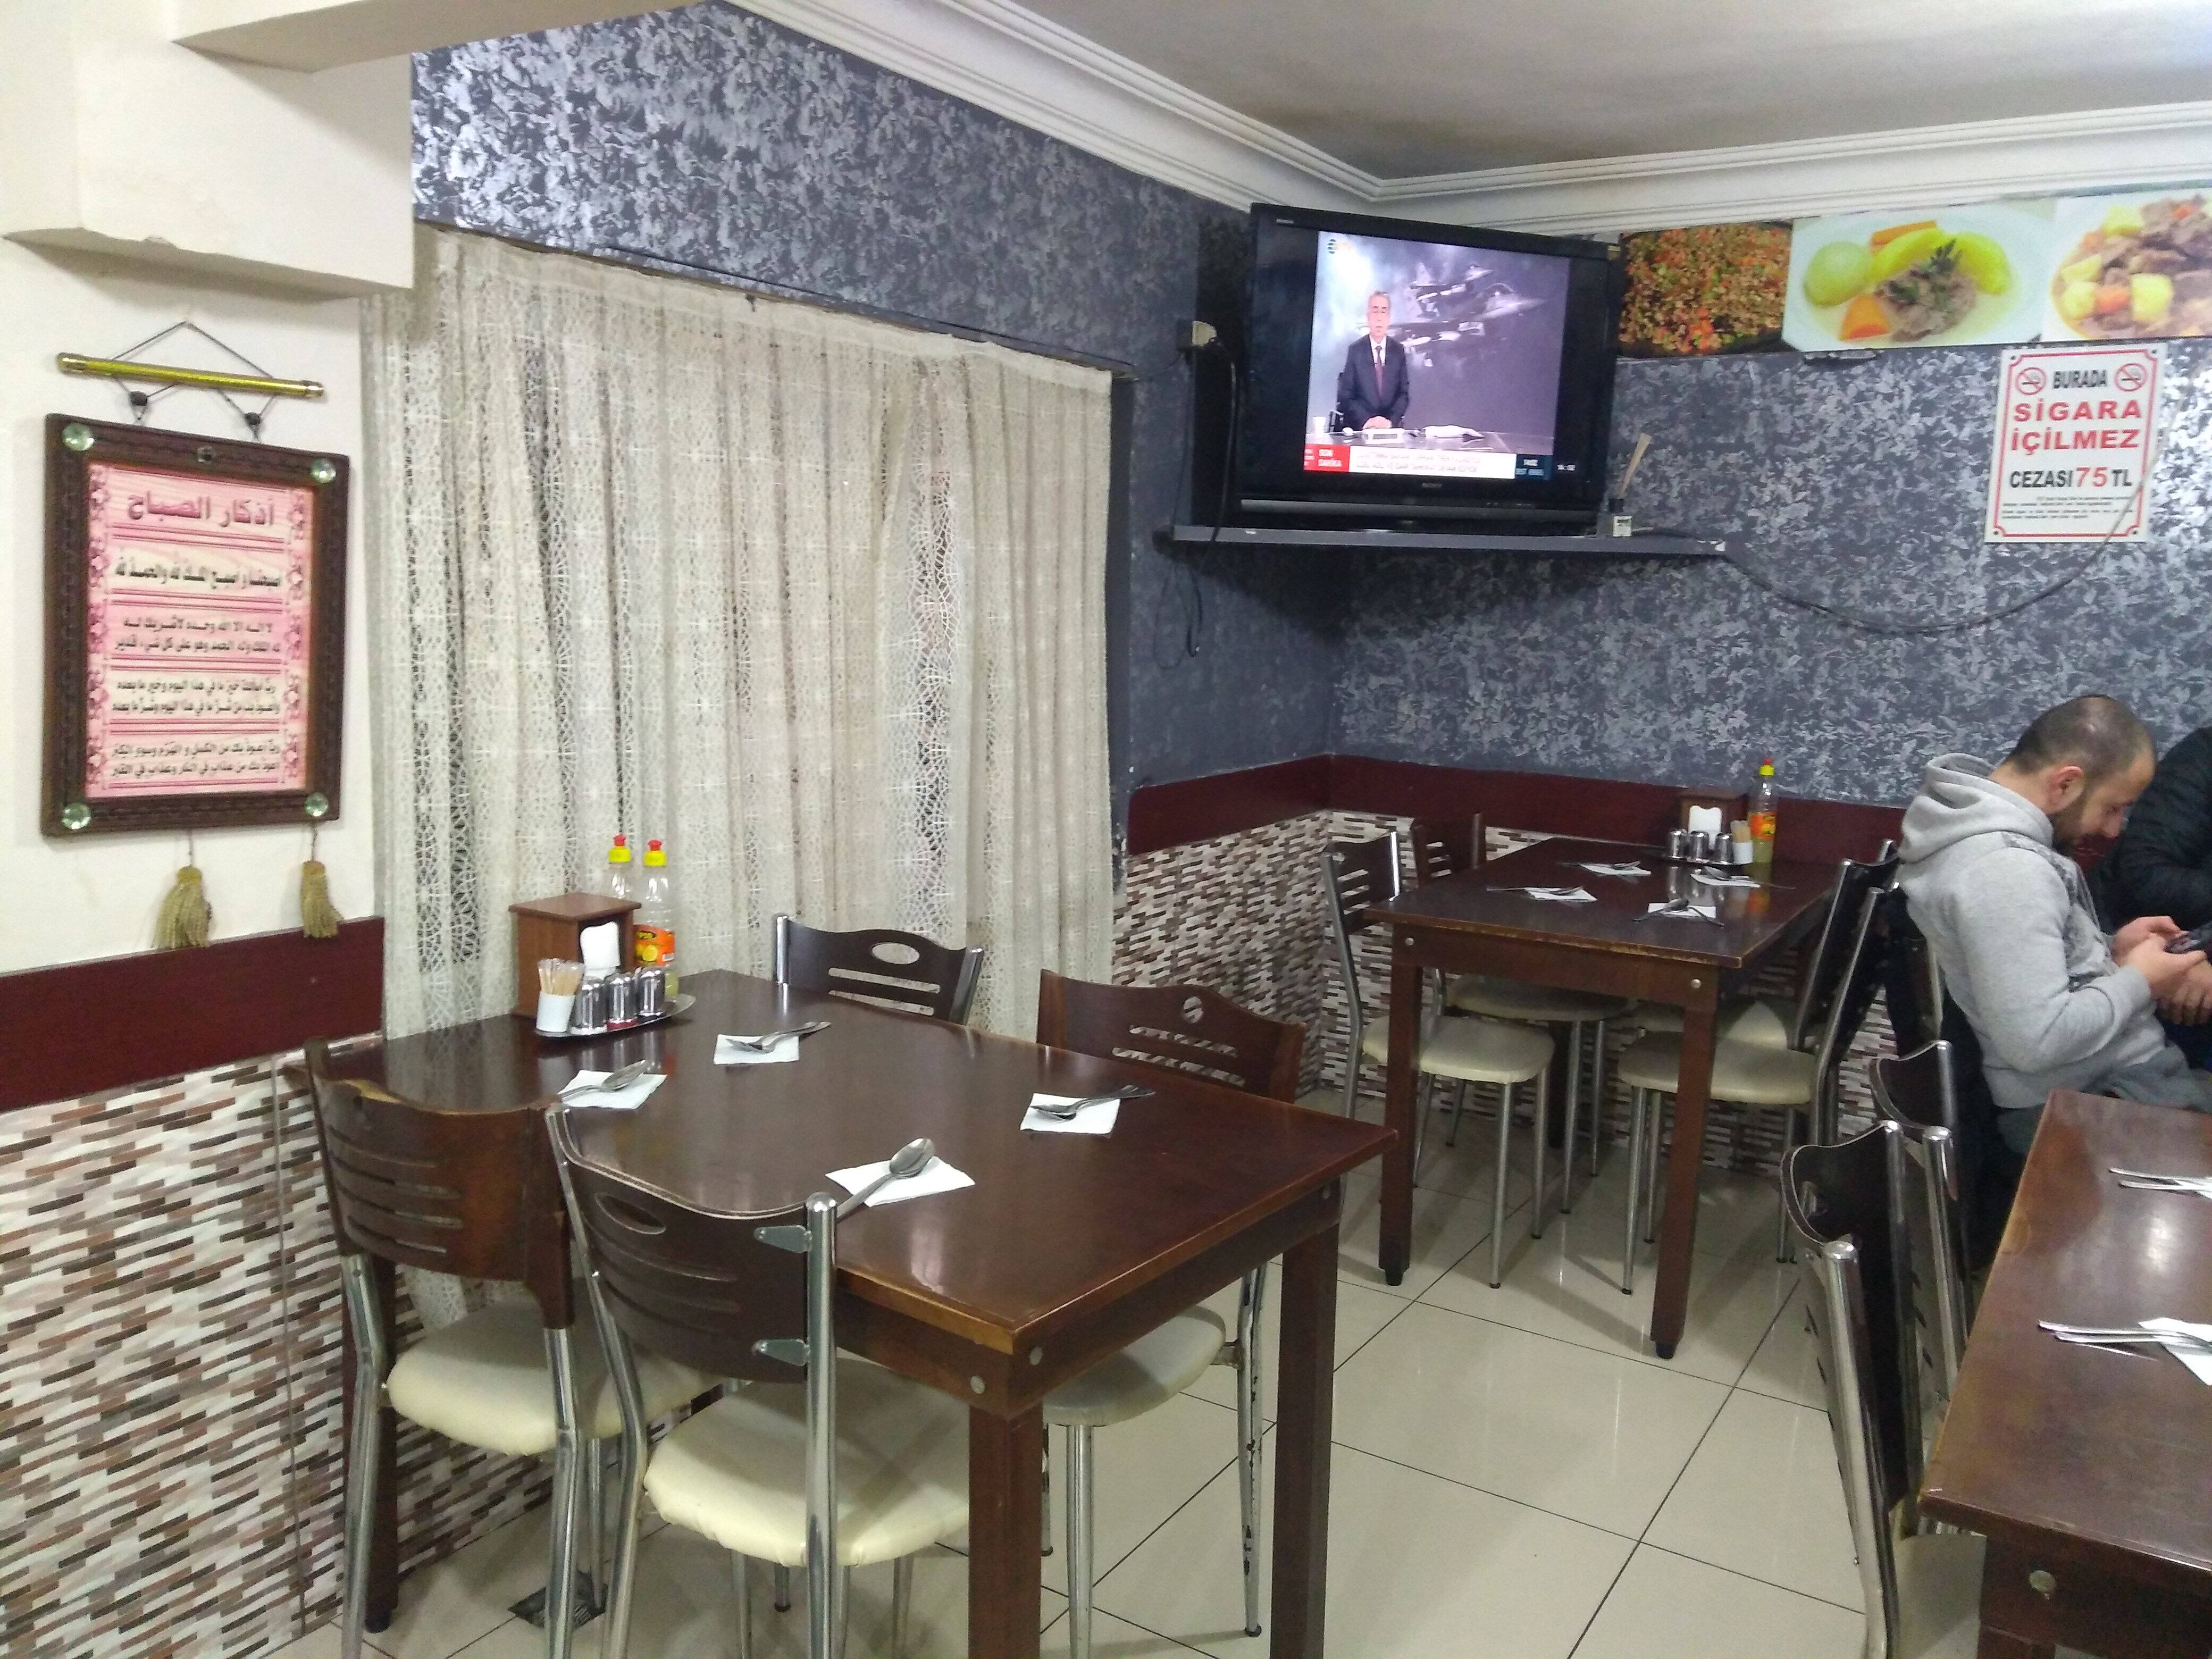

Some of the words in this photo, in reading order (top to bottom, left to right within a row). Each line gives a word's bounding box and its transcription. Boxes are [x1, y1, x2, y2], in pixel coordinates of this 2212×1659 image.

[2052, 370, 2107, 389] BURADA
[2013, 399, 2142, 422] SİGARA
[2011, 427, 2140, 455] İÇİLMEZ
[2010, 469, 2073, 489] CEZASI
[2076, 467, 2107, 487] 75
[2112, 469, 2133, 487] TL
